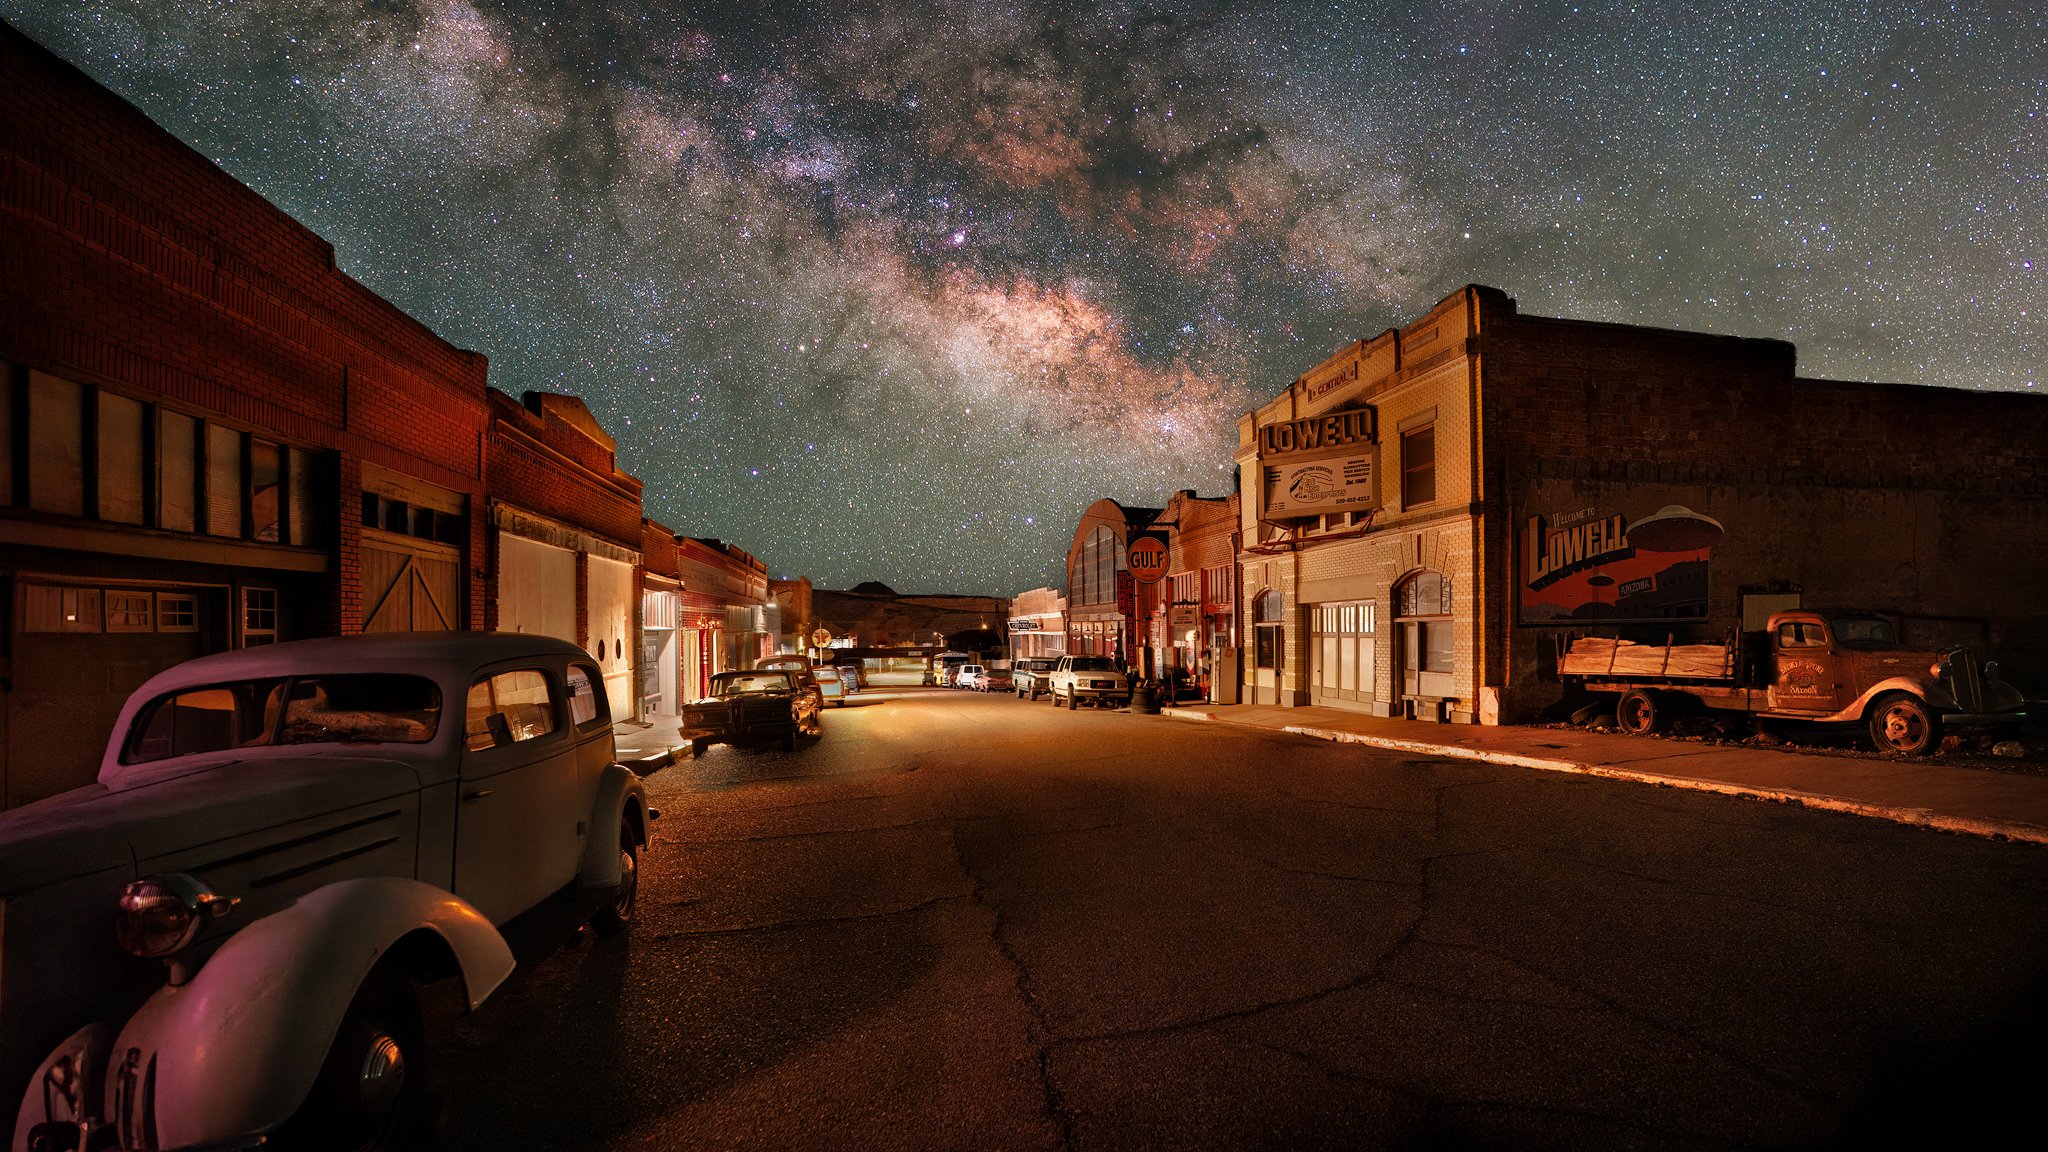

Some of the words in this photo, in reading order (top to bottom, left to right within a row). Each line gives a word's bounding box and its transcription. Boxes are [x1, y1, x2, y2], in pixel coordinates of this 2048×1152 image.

[1317, 372, 1349, 395] CENTRAL
[1264, 413, 1368, 454] LOWELL
[1130, 551, 1165, 569] GULF
[1620, 579, 1651, 595] ARIZONA
[1789, 684, 1817, 694] SALOON
